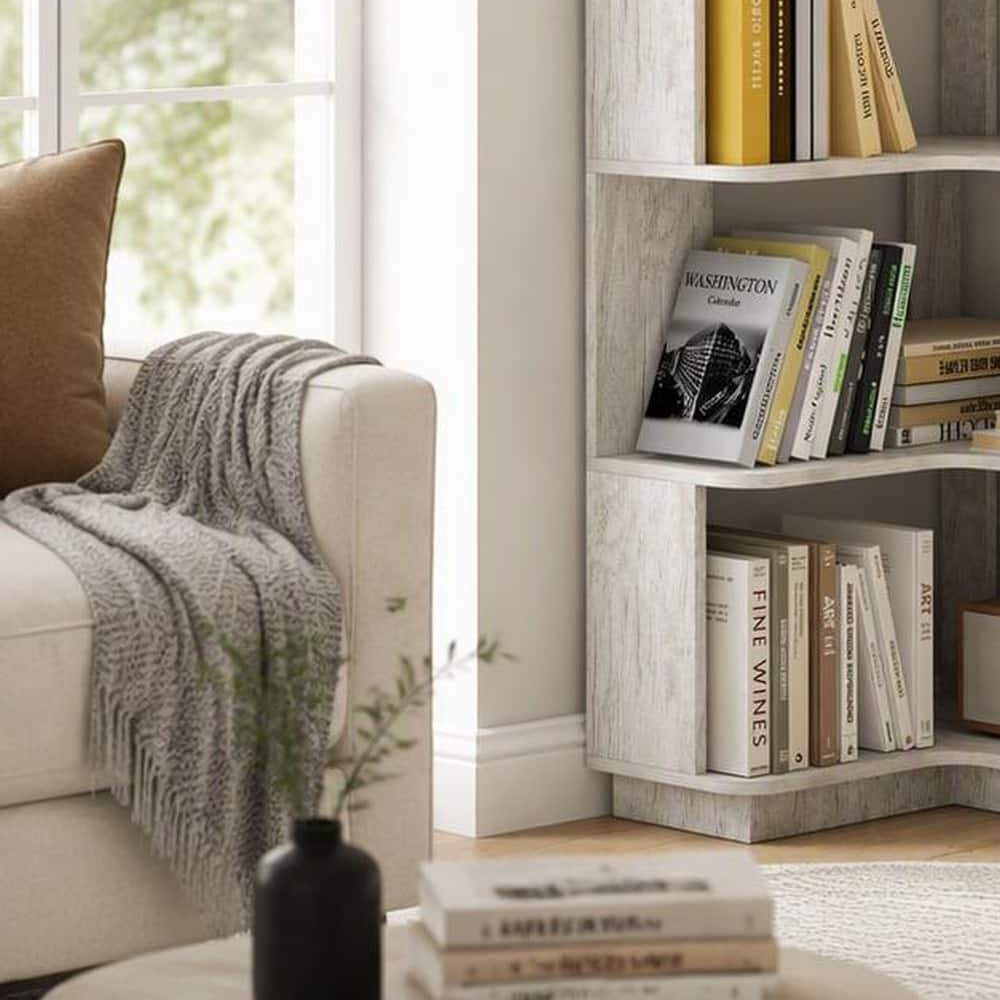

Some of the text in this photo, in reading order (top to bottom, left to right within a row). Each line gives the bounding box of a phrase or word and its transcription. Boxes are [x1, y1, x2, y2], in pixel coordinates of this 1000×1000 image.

[684, 270, 778, 296] WASHINGTON
[752, 588, 767, 748] FINE WINES
